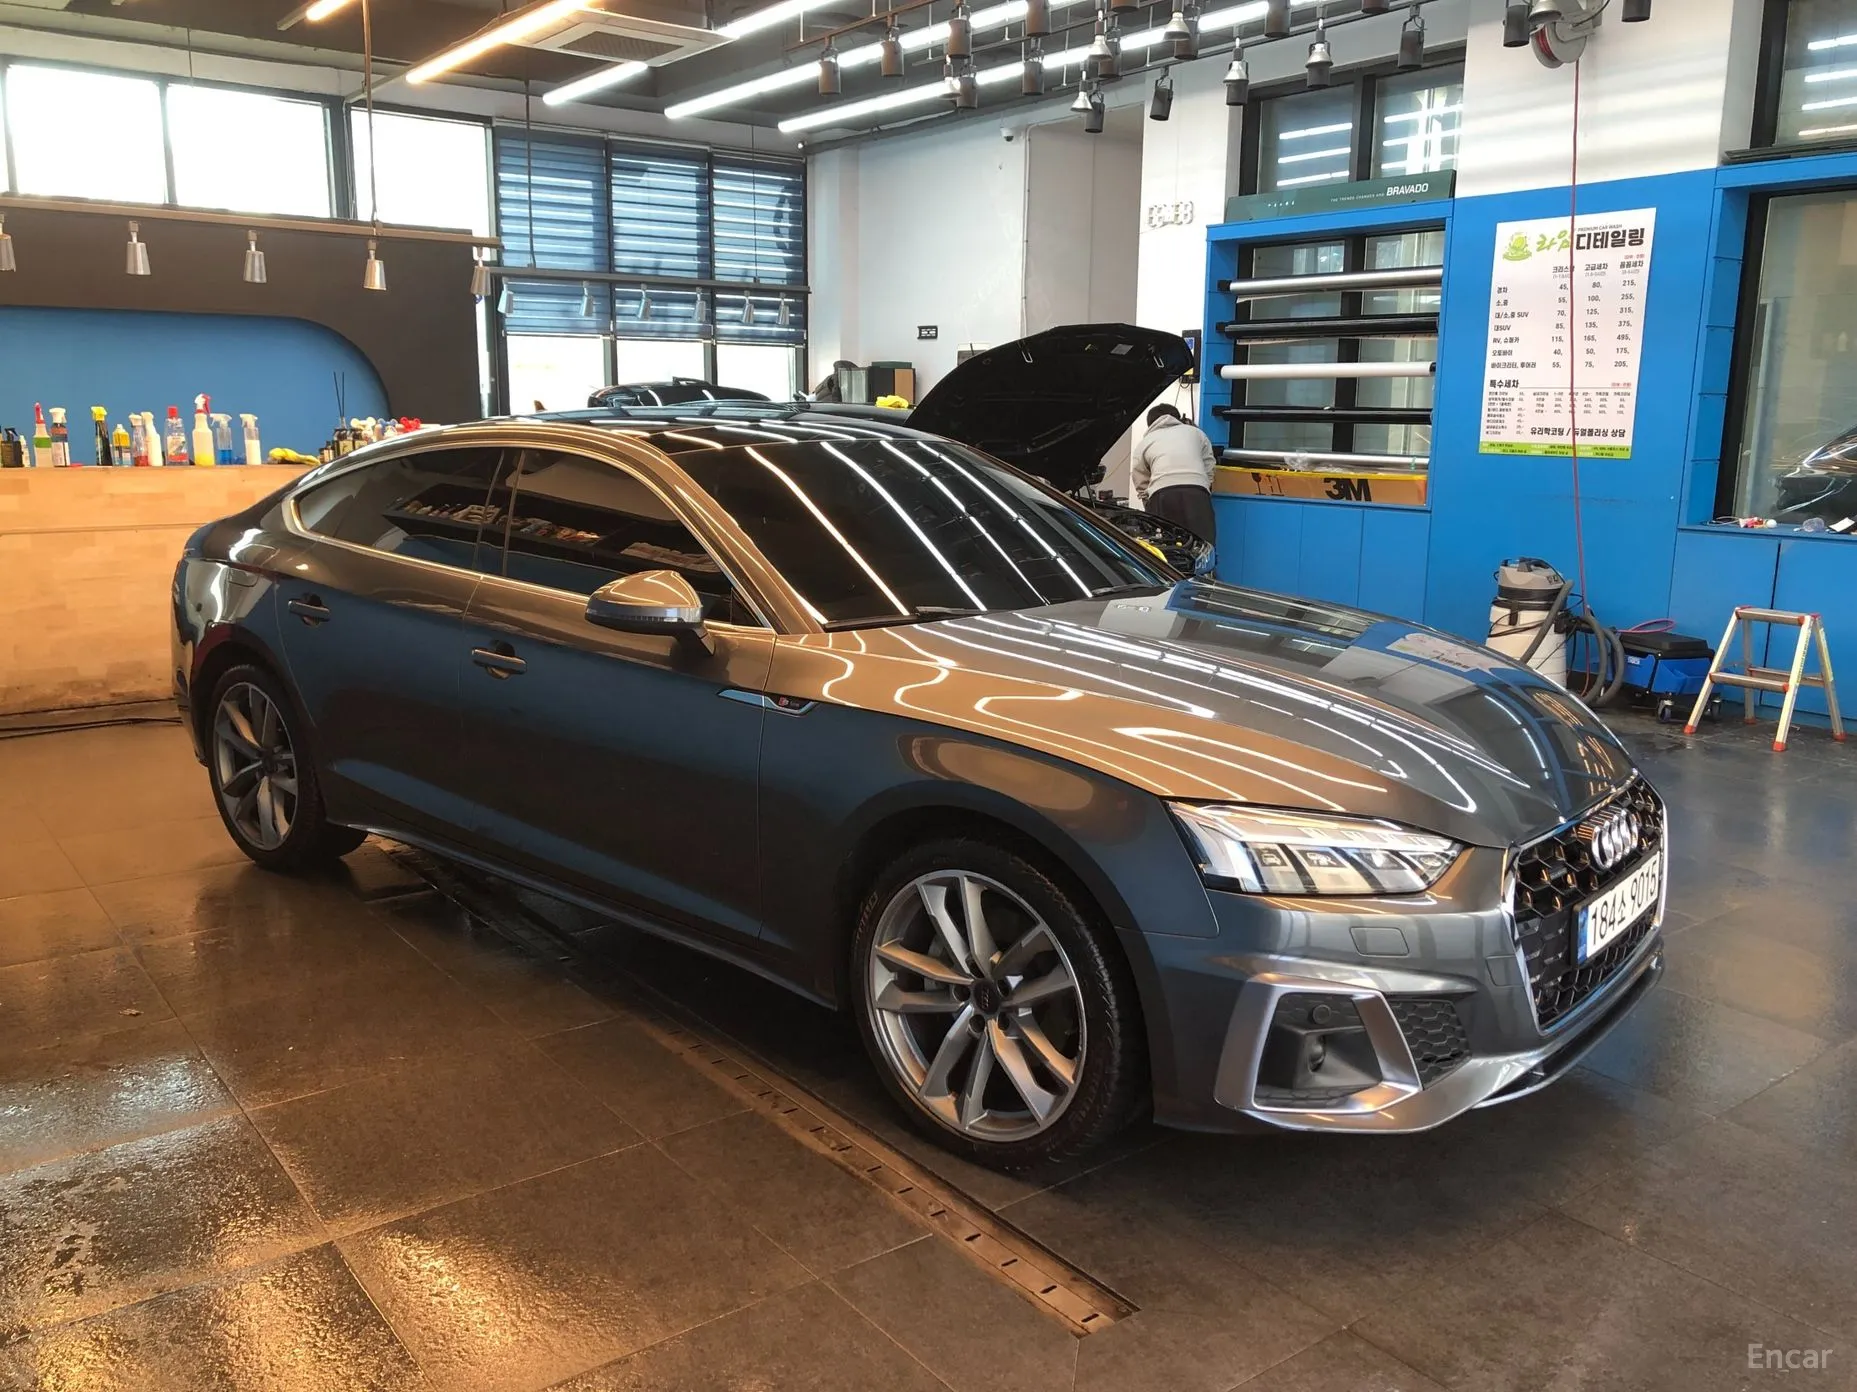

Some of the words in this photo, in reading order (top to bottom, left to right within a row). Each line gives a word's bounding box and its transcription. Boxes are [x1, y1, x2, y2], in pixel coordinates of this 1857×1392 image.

[1386, 183, 1429, 197] BRAVADO
[1576, 228, 1645, 250] 디테일링
[1552, 265, 1575, 273] 크리스
[1584, 263, 1608, 271] 고급세차
[1489, 379, 1519, 388] 특수세차
[1610, 429, 1626, 438] 상담
[1323, 478, 1372, 501] 3M
[1591, 889, 1626, 945] 184소
[1630, 860, 1657, 915] 9015
